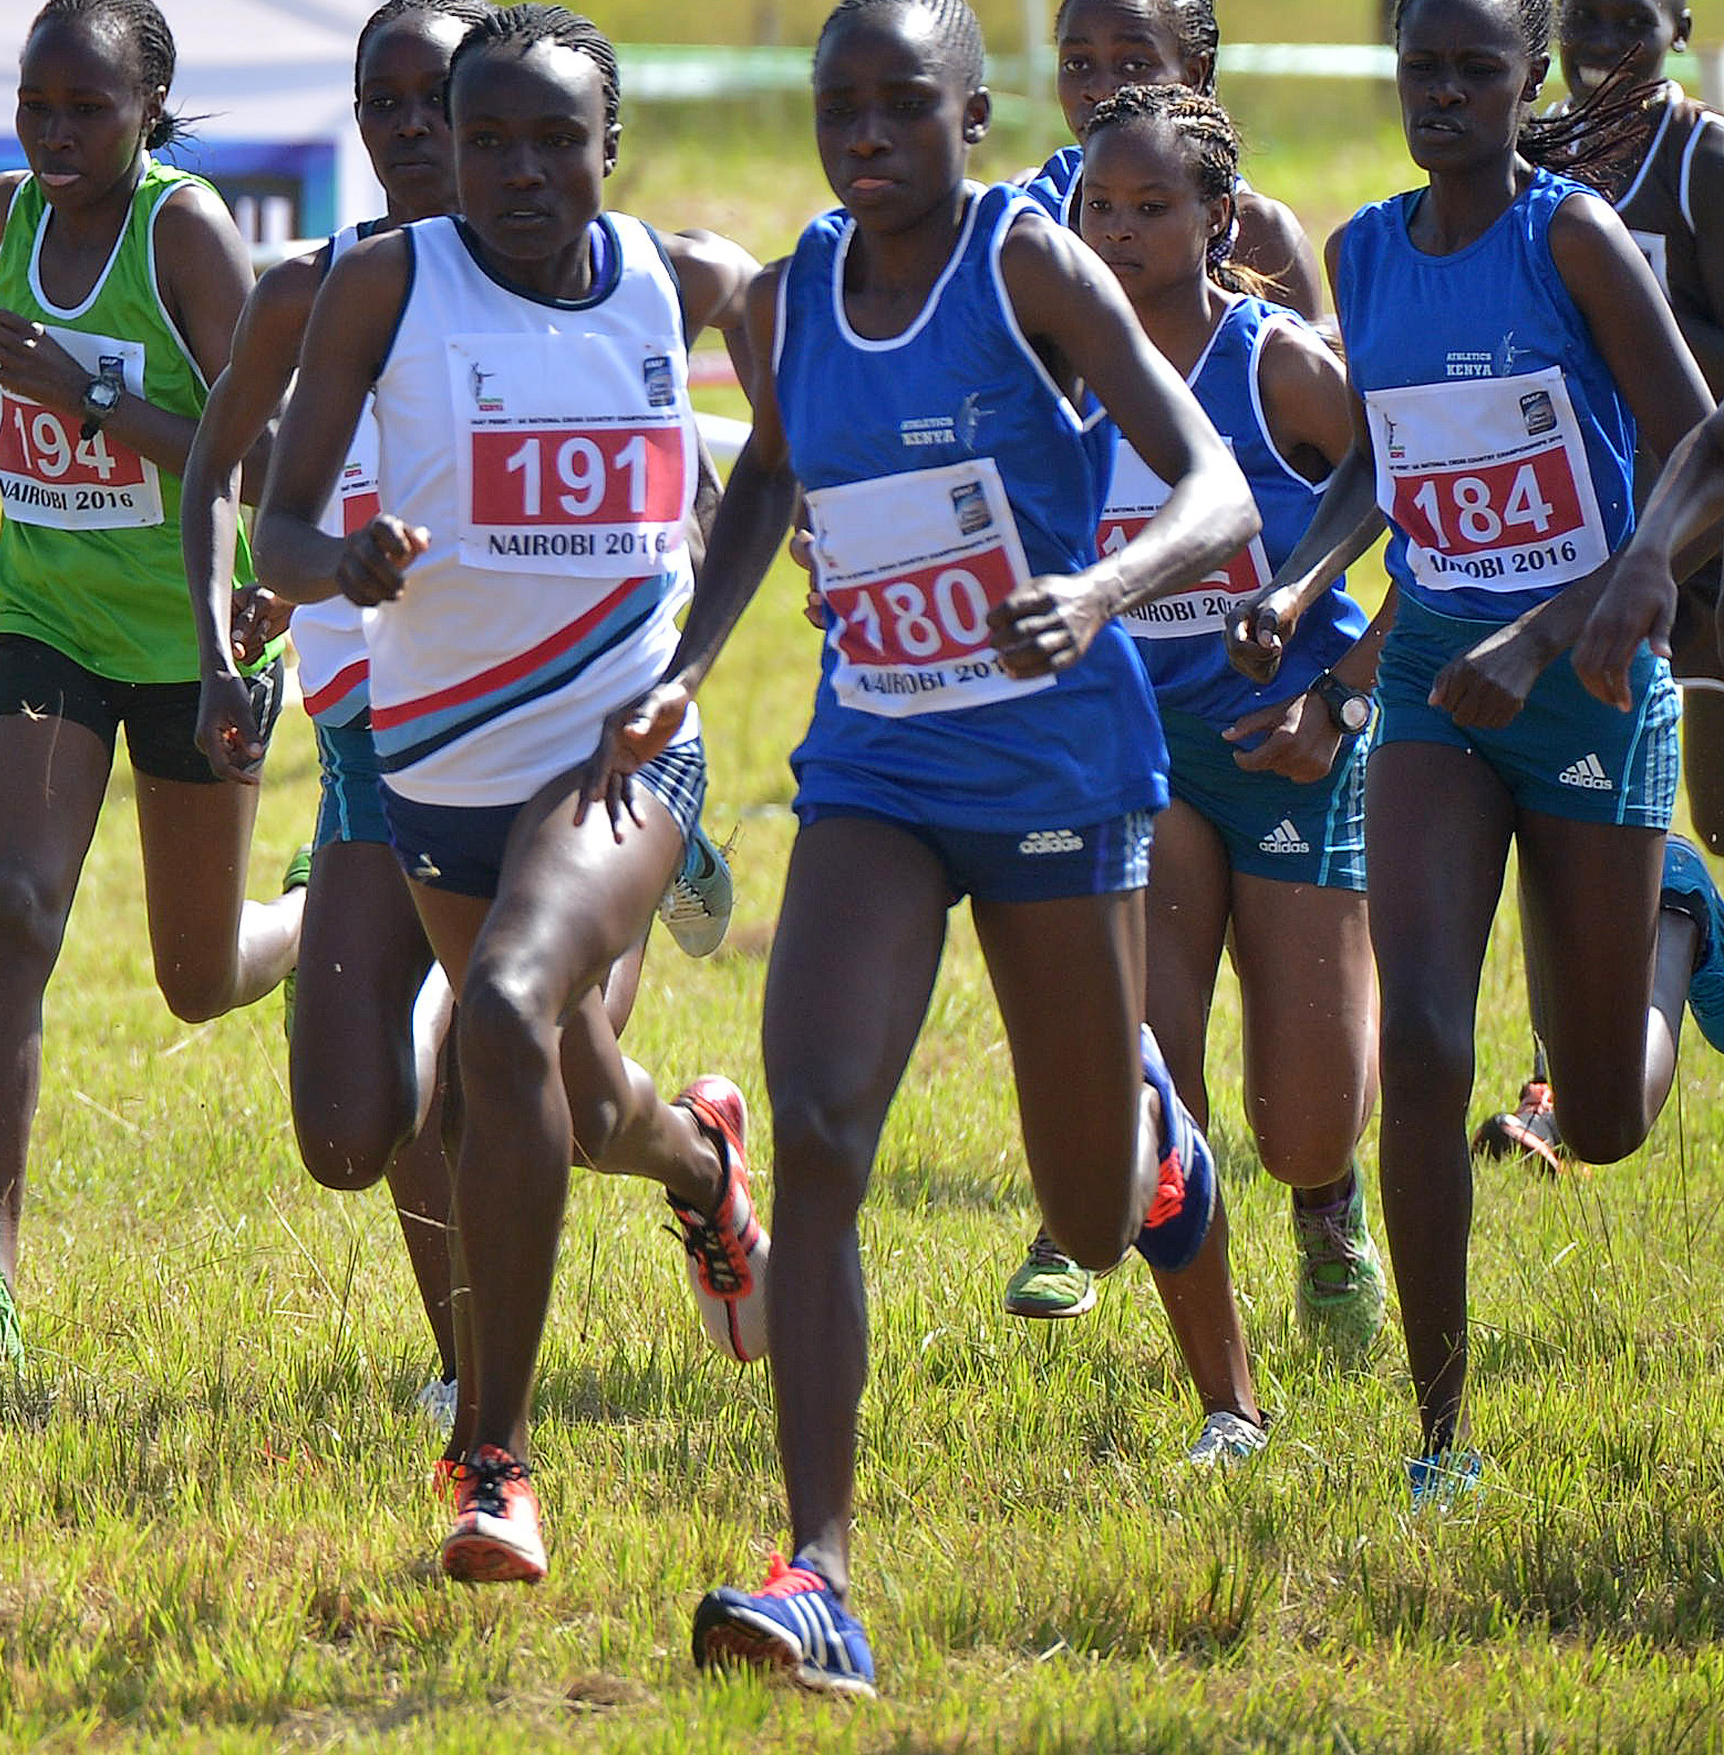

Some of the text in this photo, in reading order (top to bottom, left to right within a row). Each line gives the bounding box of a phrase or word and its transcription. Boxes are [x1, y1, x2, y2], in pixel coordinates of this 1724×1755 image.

[1446, 363, 1493, 376] KENYA
[14, 406, 117, 480] 194
[506, 434, 649, 518] 191
[75, 490, 134, 511] 2016
[1413, 463, 1553, 549] 184
[488, 532, 669, 558] NAIROBI 2016
[1512, 540, 1578, 573] 2016
[850, 567, 991, 657] 180
[1558, 771, 1613, 790] adidas
[1258, 841, 1310, 854] adidas
